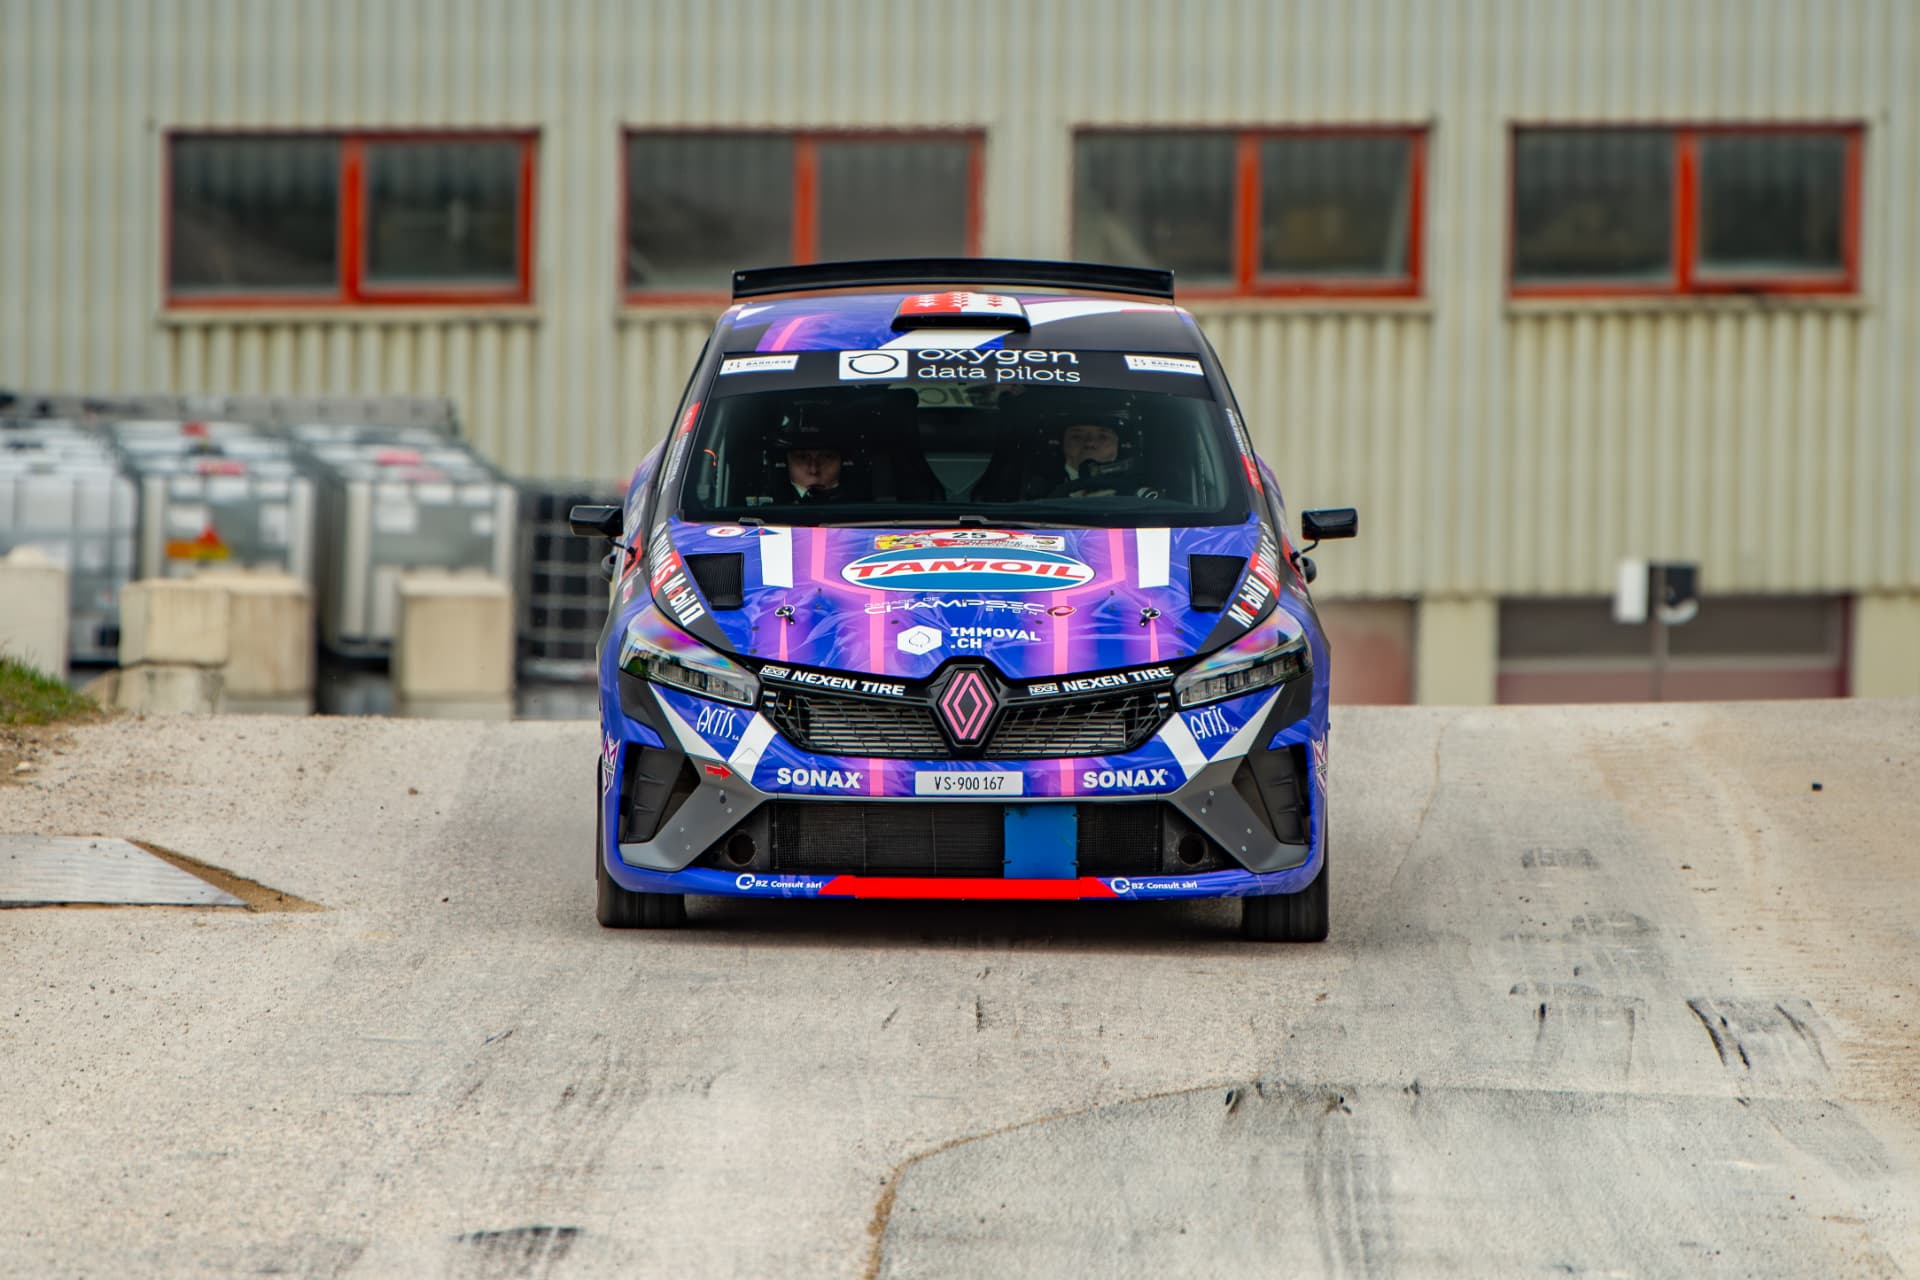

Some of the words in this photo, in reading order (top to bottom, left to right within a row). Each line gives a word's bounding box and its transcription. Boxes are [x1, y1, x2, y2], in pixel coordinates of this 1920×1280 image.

[917, 349, 1079, 365] oxygen
[917, 365, 987, 378] data
[995, 366, 1081, 383] pilots
[850, 560, 1085, 579] TAMOIL
[864, 599, 1045, 615] CHAMPSEC
[951, 627, 1041, 641] IMMOVAL
[951, 638, 982, 649] .CH
[791, 670, 856, 690] NEXEN
[860, 681, 906, 696] TIRE
[1062, 673, 1128, 692] NEXEN
[1128, 666, 1174, 682] TIRE
[776, 767, 862, 789] SONAX
[1083, 768, 1167, 789] SONAX
[771, 880, 804, 888] Consult
[1147, 881, 1180, 889] Consult
